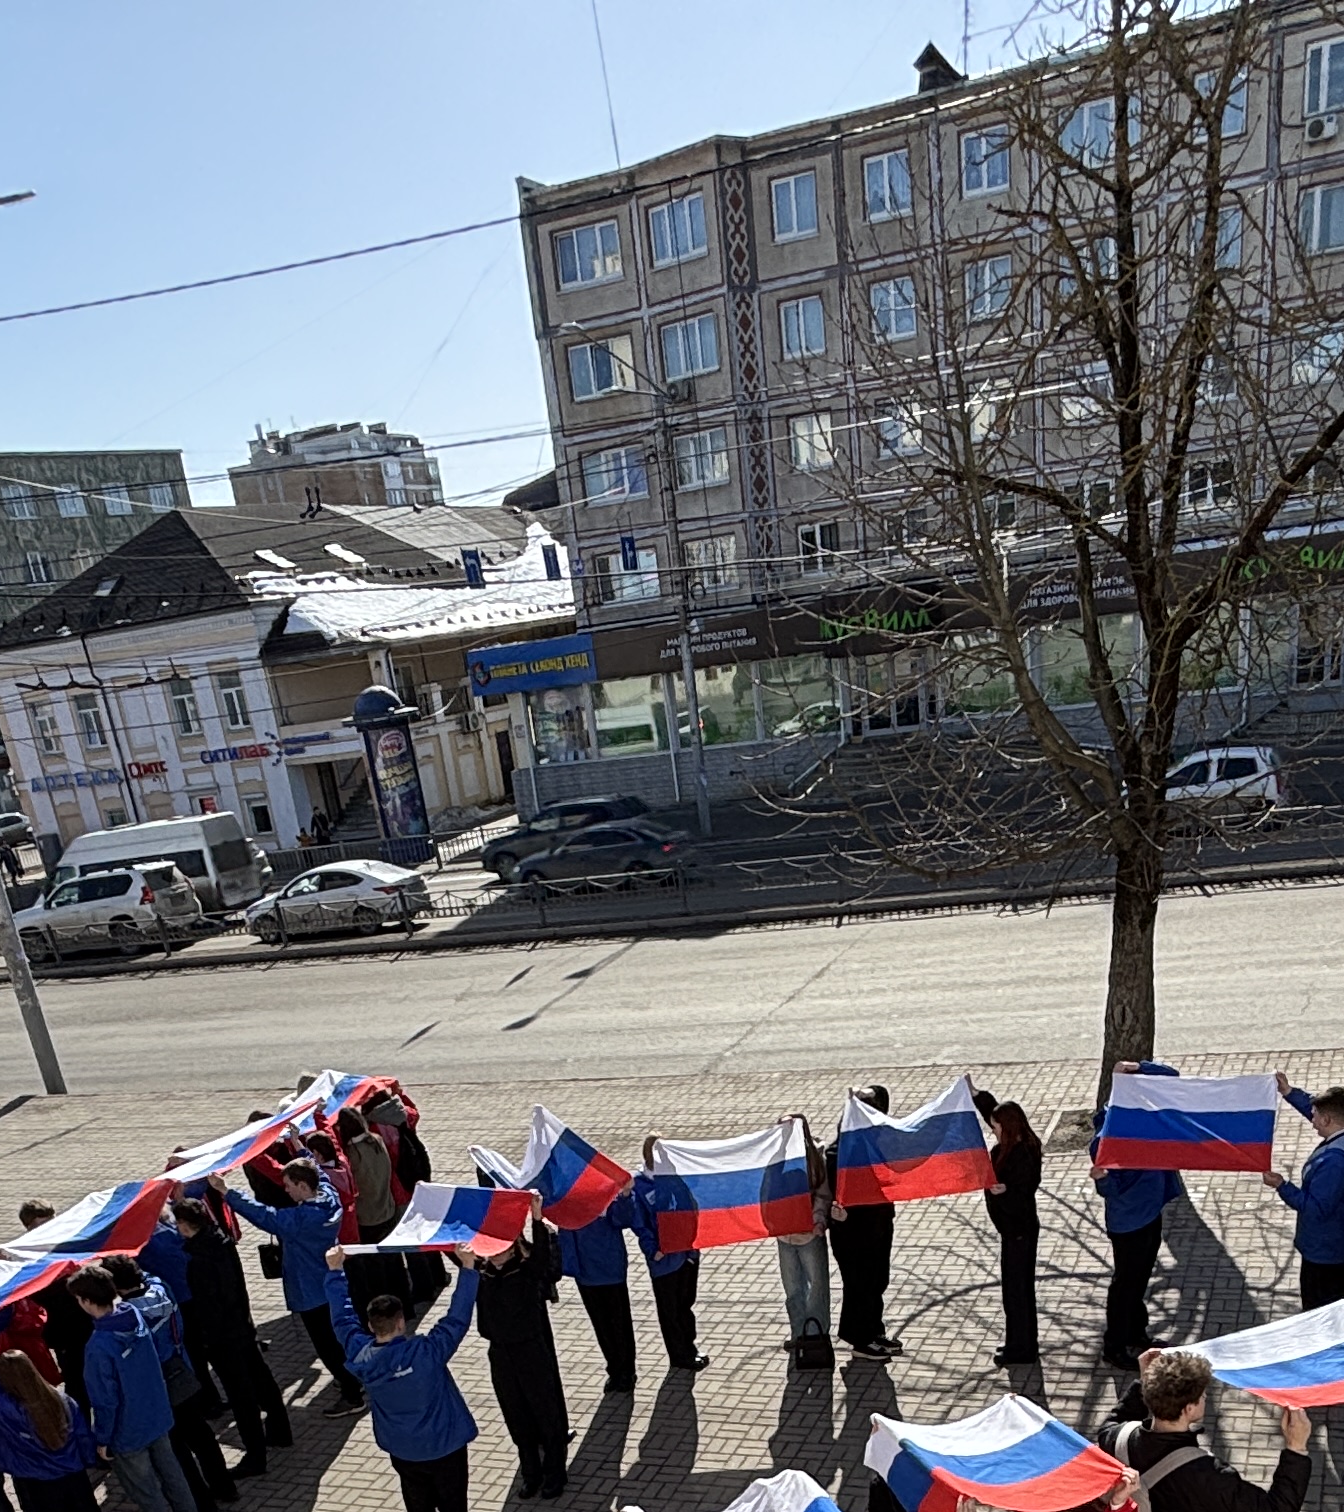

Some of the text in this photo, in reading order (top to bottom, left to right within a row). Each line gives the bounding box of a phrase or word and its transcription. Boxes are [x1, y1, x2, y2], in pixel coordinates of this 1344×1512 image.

[564, 652, 589, 669] ХЕНД
[660, 648, 676, 659] ДЛЯ
[31, 768, 122, 793] АПТЕКА
